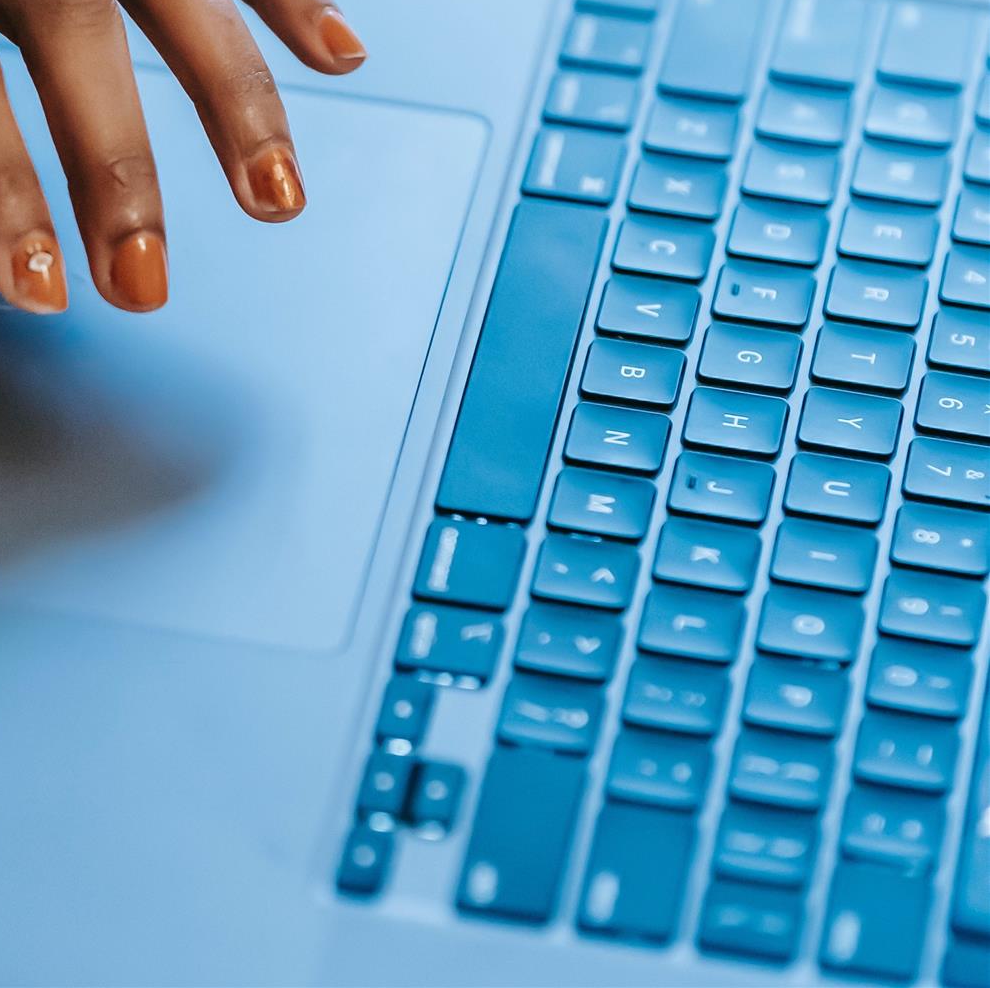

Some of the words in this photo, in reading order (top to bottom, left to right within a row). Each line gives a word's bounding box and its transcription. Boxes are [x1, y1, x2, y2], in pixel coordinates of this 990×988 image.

[664, 178, 692, 196] X
[763, 224, 792, 241] D
[873, 225, 903, 240] E
[649, 240, 677, 255] C
[963, 270, 987, 285] 4
[753, 287, 777, 300] F
[864, 287, 890, 302] R
[635, 304, 662, 318] V
[950, 333, 976, 347] 5
[737, 350, 763, 364] G
[850, 353, 876, 365] T
[620, 365, 646, 379] B
[938, 397, 964, 410] 6
[721, 414, 749, 429] H
[837, 418, 863, 429] Y
[603, 430, 631, 446] N
[927, 464, 952, 477] 7
[965, 469, 985, 480] &
[707, 481, 733, 495] J
[822, 480, 851, 497] U
[587, 495, 615, 514] M
[912, 529, 941, 545] 8
[690, 546, 720, 564] K
[673, 616, 705, 630] L
[793, 616, 824, 635] O
